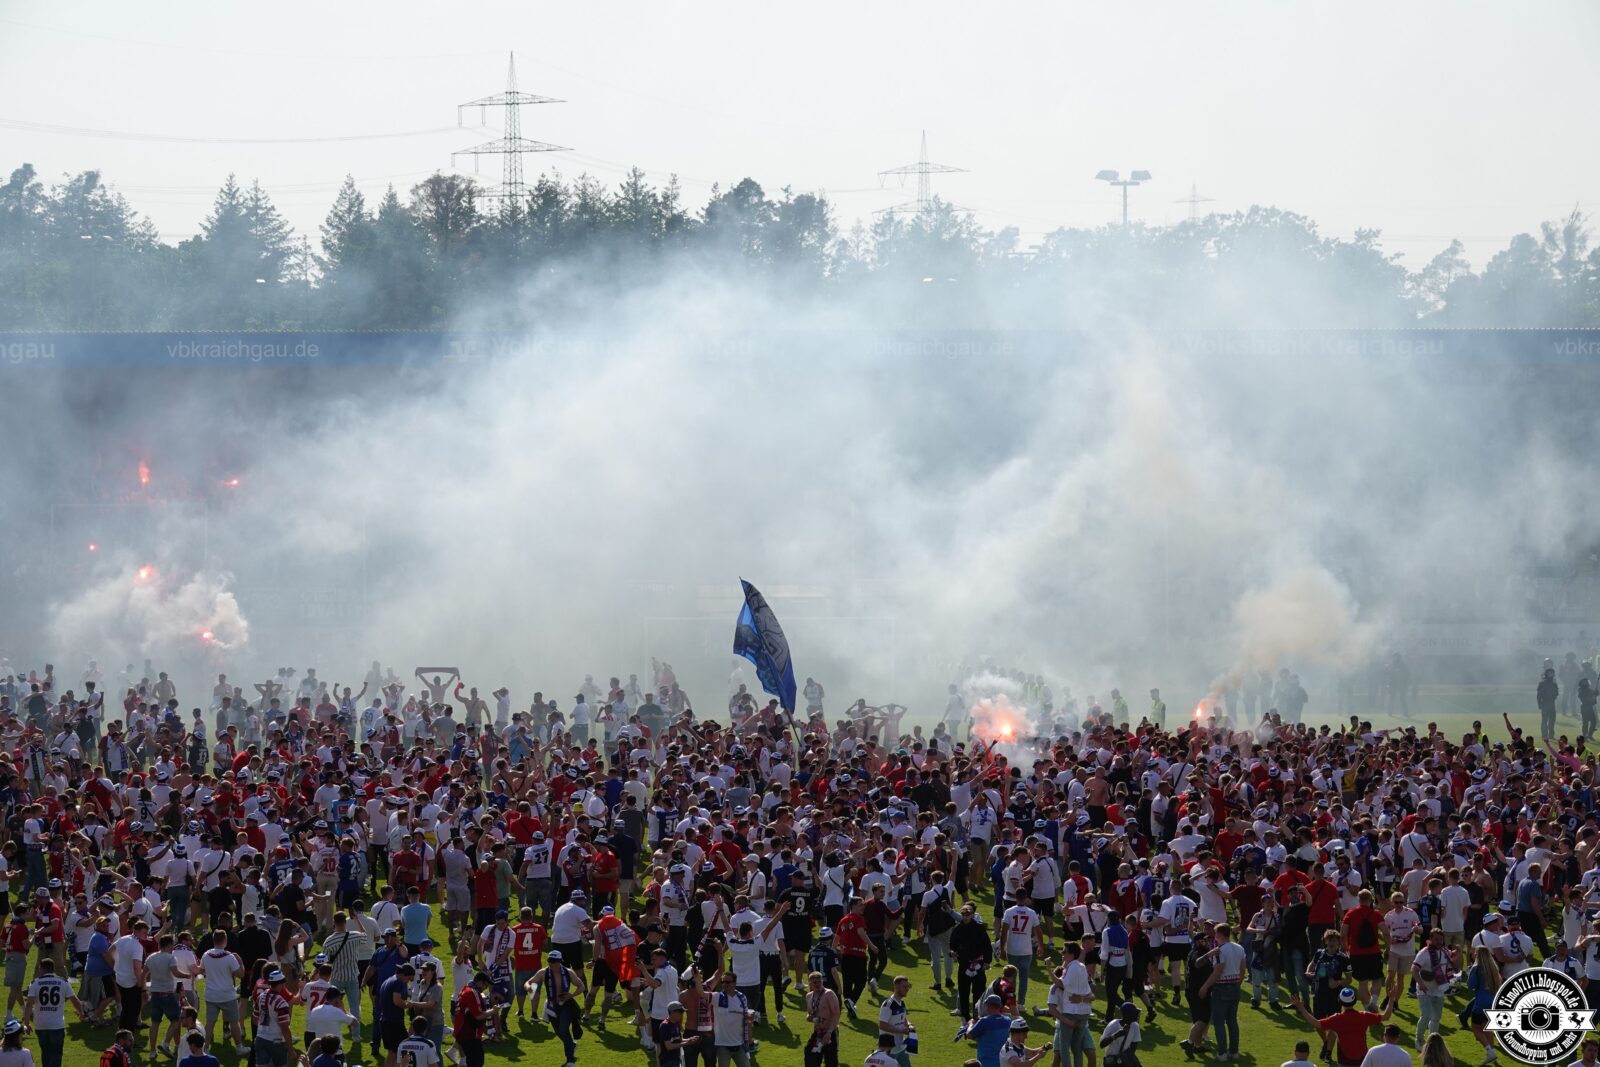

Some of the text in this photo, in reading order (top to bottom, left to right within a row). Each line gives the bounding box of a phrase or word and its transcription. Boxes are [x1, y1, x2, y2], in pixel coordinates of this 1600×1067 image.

[167, 340, 319, 361] vbkraichgau.de
[1568, 817, 1577, 831] 9
[796, 896, 805, 912] 9
[1012, 915, 1029, 932] 17
[522, 932, 534, 950] 4
[39, 985, 60, 1006] 66
